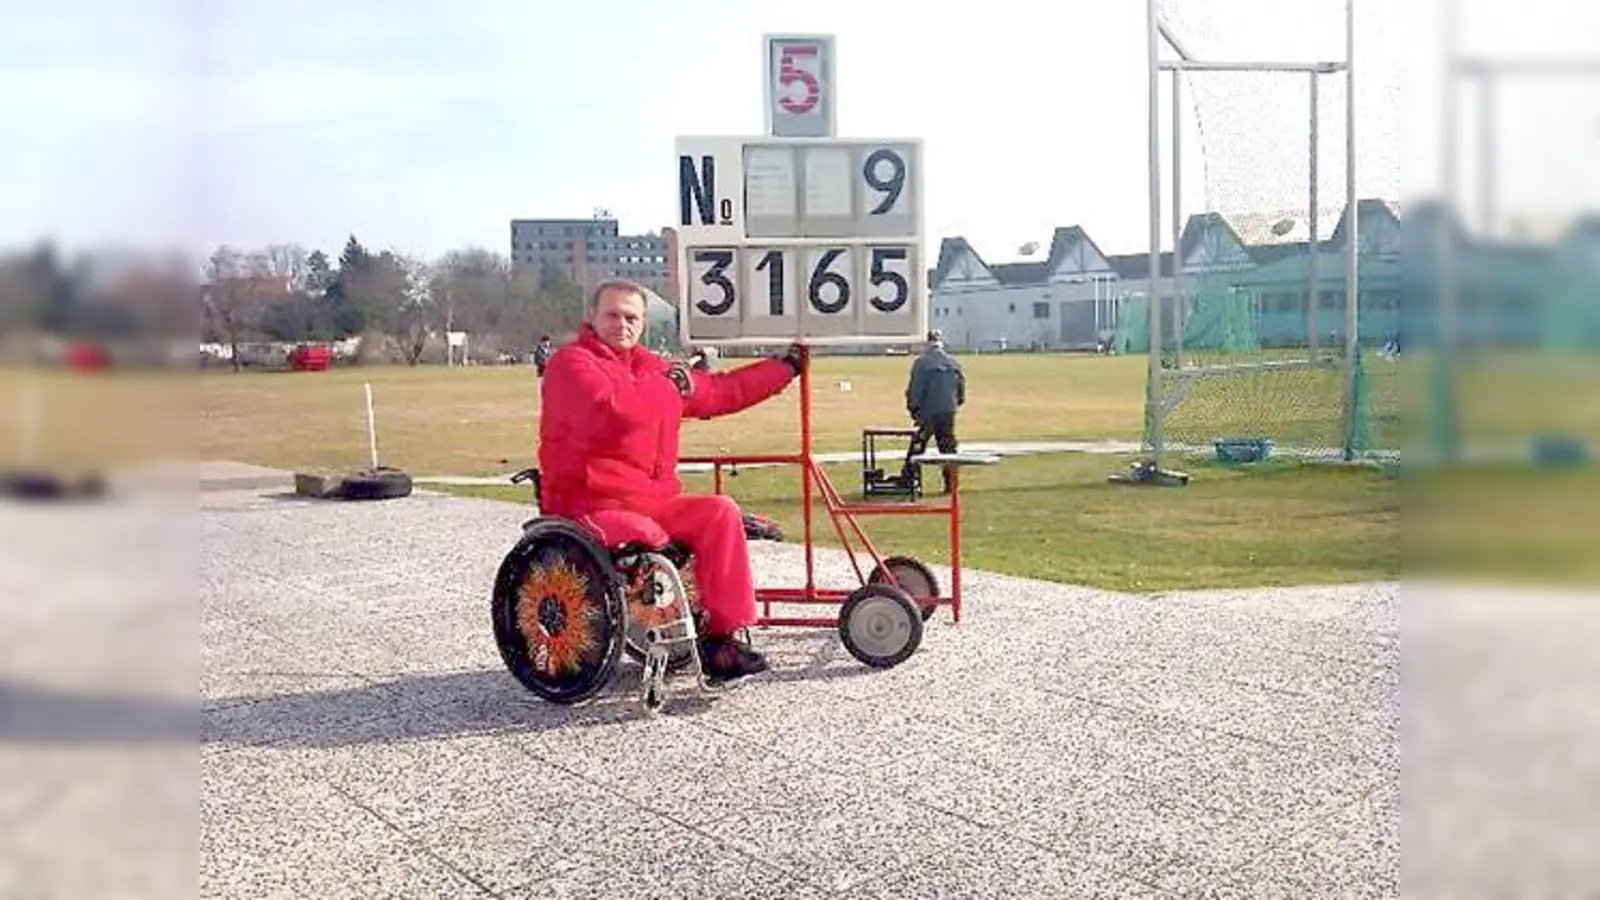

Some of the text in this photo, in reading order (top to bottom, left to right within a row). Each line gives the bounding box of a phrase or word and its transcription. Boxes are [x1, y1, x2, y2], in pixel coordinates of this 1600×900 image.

[779, 45, 820, 114] 5
[863, 148, 906, 215] 9
[694, 248, 908, 316] 3165
